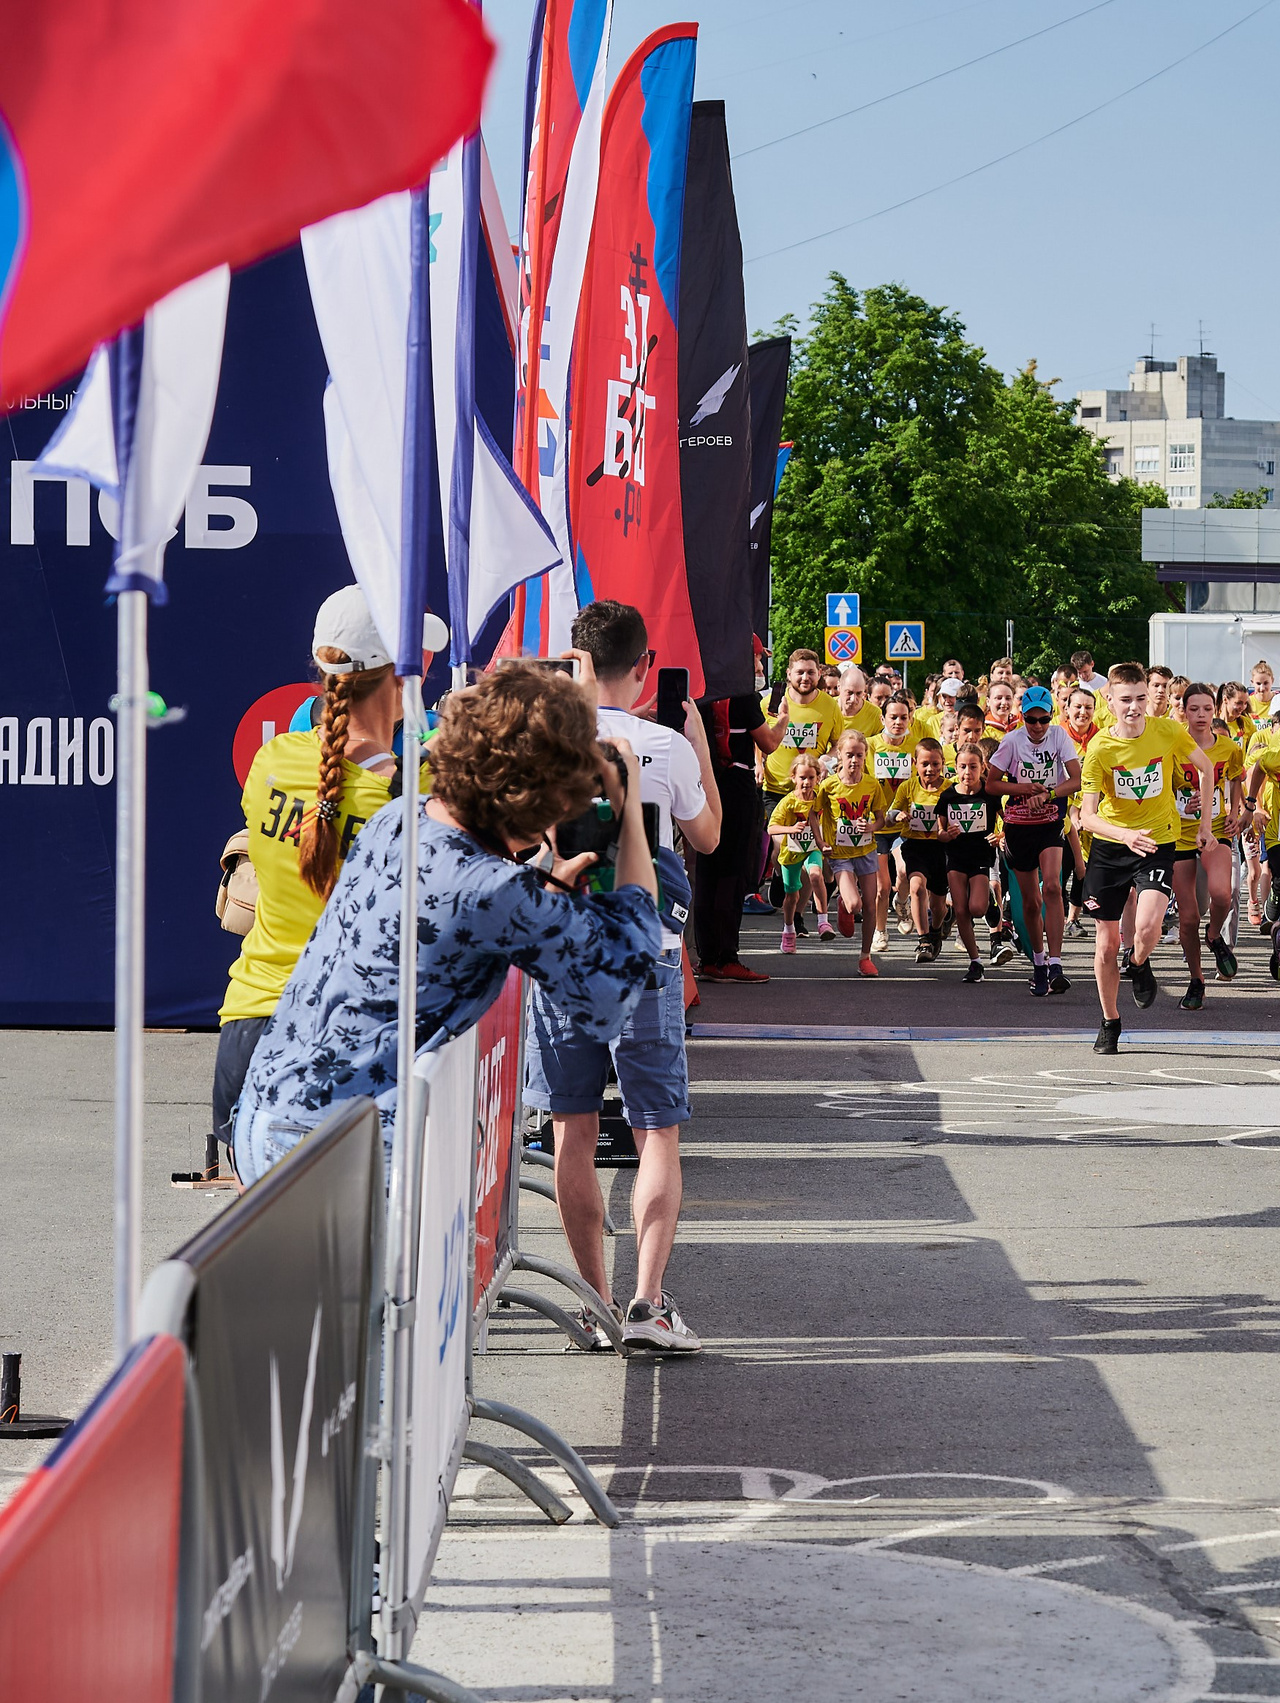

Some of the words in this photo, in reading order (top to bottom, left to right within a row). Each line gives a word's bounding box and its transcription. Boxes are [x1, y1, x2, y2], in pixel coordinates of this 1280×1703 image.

[679, 435, 733, 448] ГЕРОЕВ
[877, 758, 908, 767] 00110
[1020, 768, 1054, 778] 00141
[1117, 771, 1160, 787] 00142
[949, 810, 984, 820] 00129
[1148, 869, 1165, 882] 17
